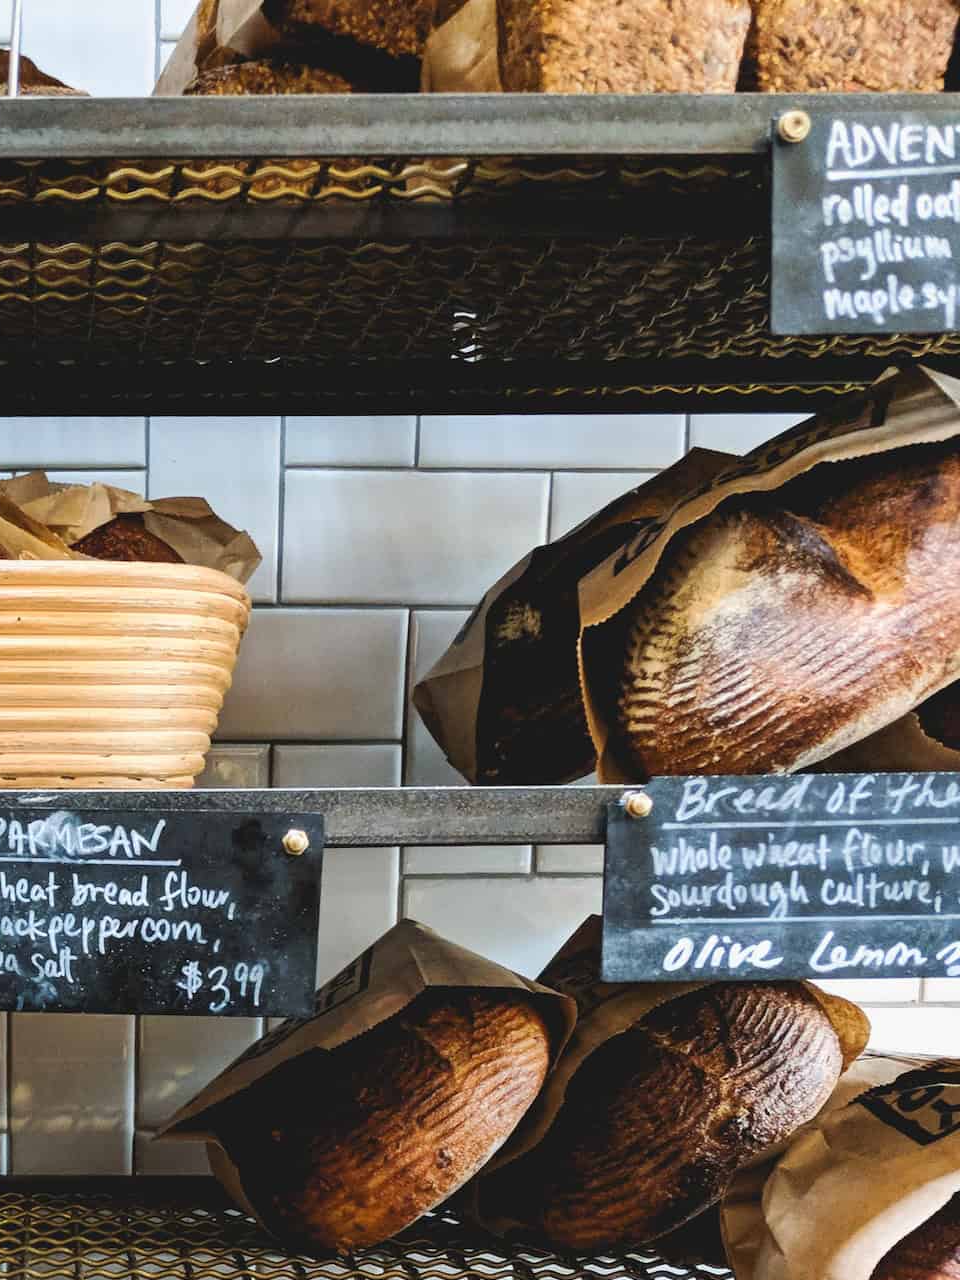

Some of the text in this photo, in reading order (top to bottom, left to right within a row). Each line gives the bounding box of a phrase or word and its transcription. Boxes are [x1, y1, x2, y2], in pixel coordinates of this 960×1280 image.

[822, 183, 909, 226] rolled
[819, 228, 952, 283] psyllium
[823, 274, 915, 325] maple
[675, 775, 814, 821] Bread
[826, 775, 876, 815] of
[650, 832, 732, 876] whole
[742, 832, 832, 873] wheat
[840, 828, 929, 876] flour,
[72, 872, 149, 907] bread
[159, 870, 237, 921] flour,
[30, 945, 79, 983] salt
[662, 934, 784, 972] Olive
[808, 930, 929, 974] Lemon
